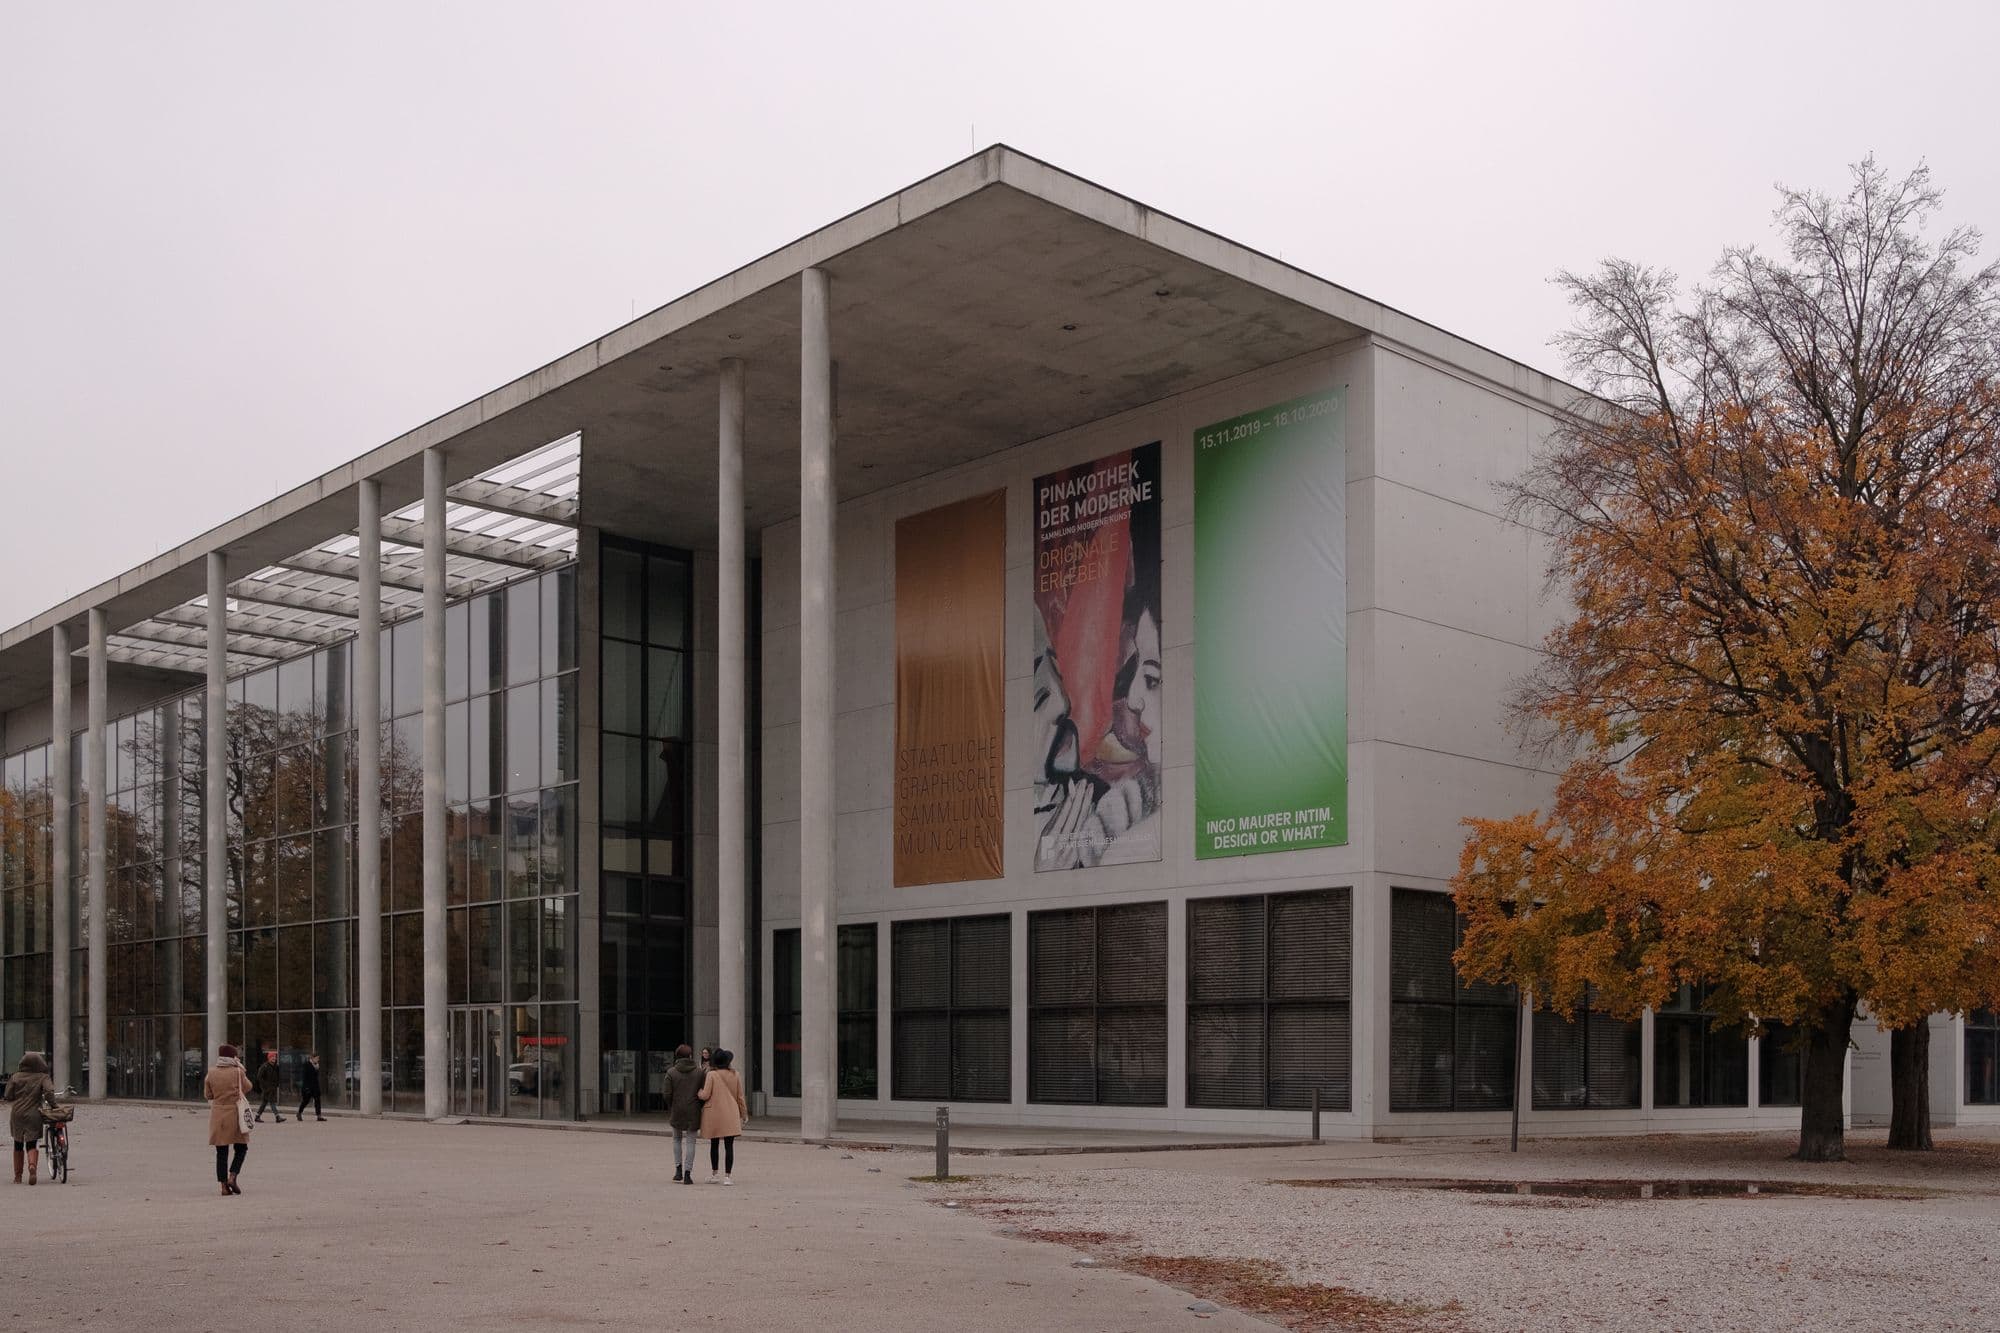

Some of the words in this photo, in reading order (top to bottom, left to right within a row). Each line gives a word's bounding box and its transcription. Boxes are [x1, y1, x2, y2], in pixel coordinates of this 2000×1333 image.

[1200, 420, 1260, 449] 15.11.2019
[1040, 460, 1140, 506] PINAKOTHEK
[1040, 504, 1070, 529] DER
[1074, 480, 1152, 518] MODERNE
[1041, 525, 1077, 542] SAMMLUNG
[1077, 516, 1109, 533] MODERNE
[1109, 510, 1132, 524] KUNST
[1040, 532, 1120, 570] ORIGINALE
[1040, 560, 1110, 593] ERLEBEN
[900, 736, 996, 772] STAATLICHE
[900, 765, 996, 800] GRAPHISCHE
[900, 794, 996, 828] SAMMLUNG
[1207, 818, 1235, 834] INGO
[1239, 812, 1291, 831] MAURER
[1214, 832, 1257, 849] DESIGN
[1261, 830, 1278, 844] OR
[1282, 824, 1326, 842] WHAT?
